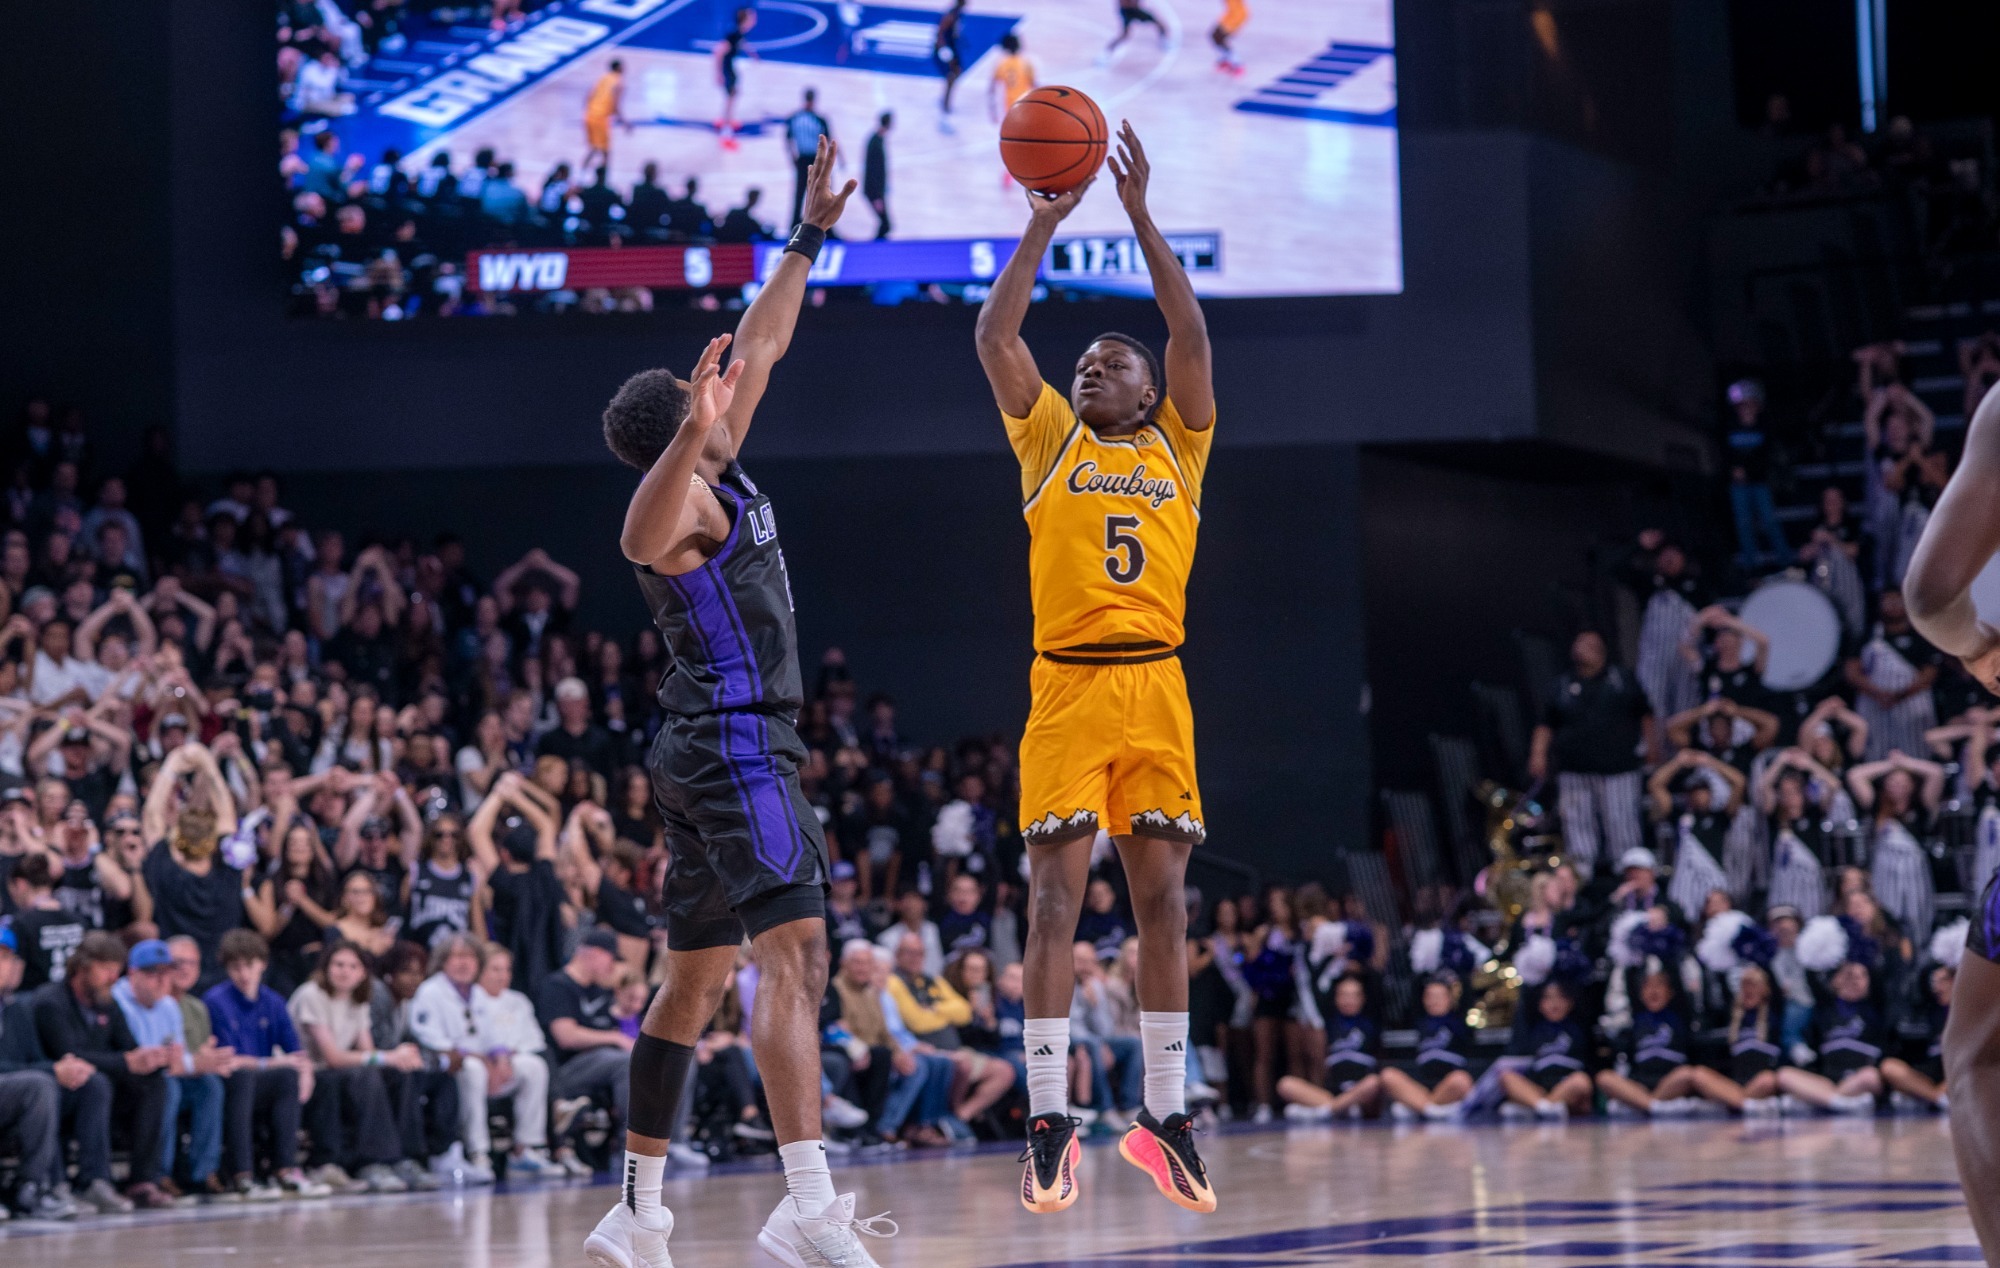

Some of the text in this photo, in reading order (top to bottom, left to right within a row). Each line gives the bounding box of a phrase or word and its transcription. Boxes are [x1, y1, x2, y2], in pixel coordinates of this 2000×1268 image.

[377, 15, 611, 127] GRAND
[478, 252, 569, 291] WYO
[683, 246, 713, 287] 5
[969, 241, 996, 278] 5
[1063, 239, 1149, 275] 17:1
[1065, 460, 1177, 510] Cowboys
[1103, 512, 1148, 585] 5
